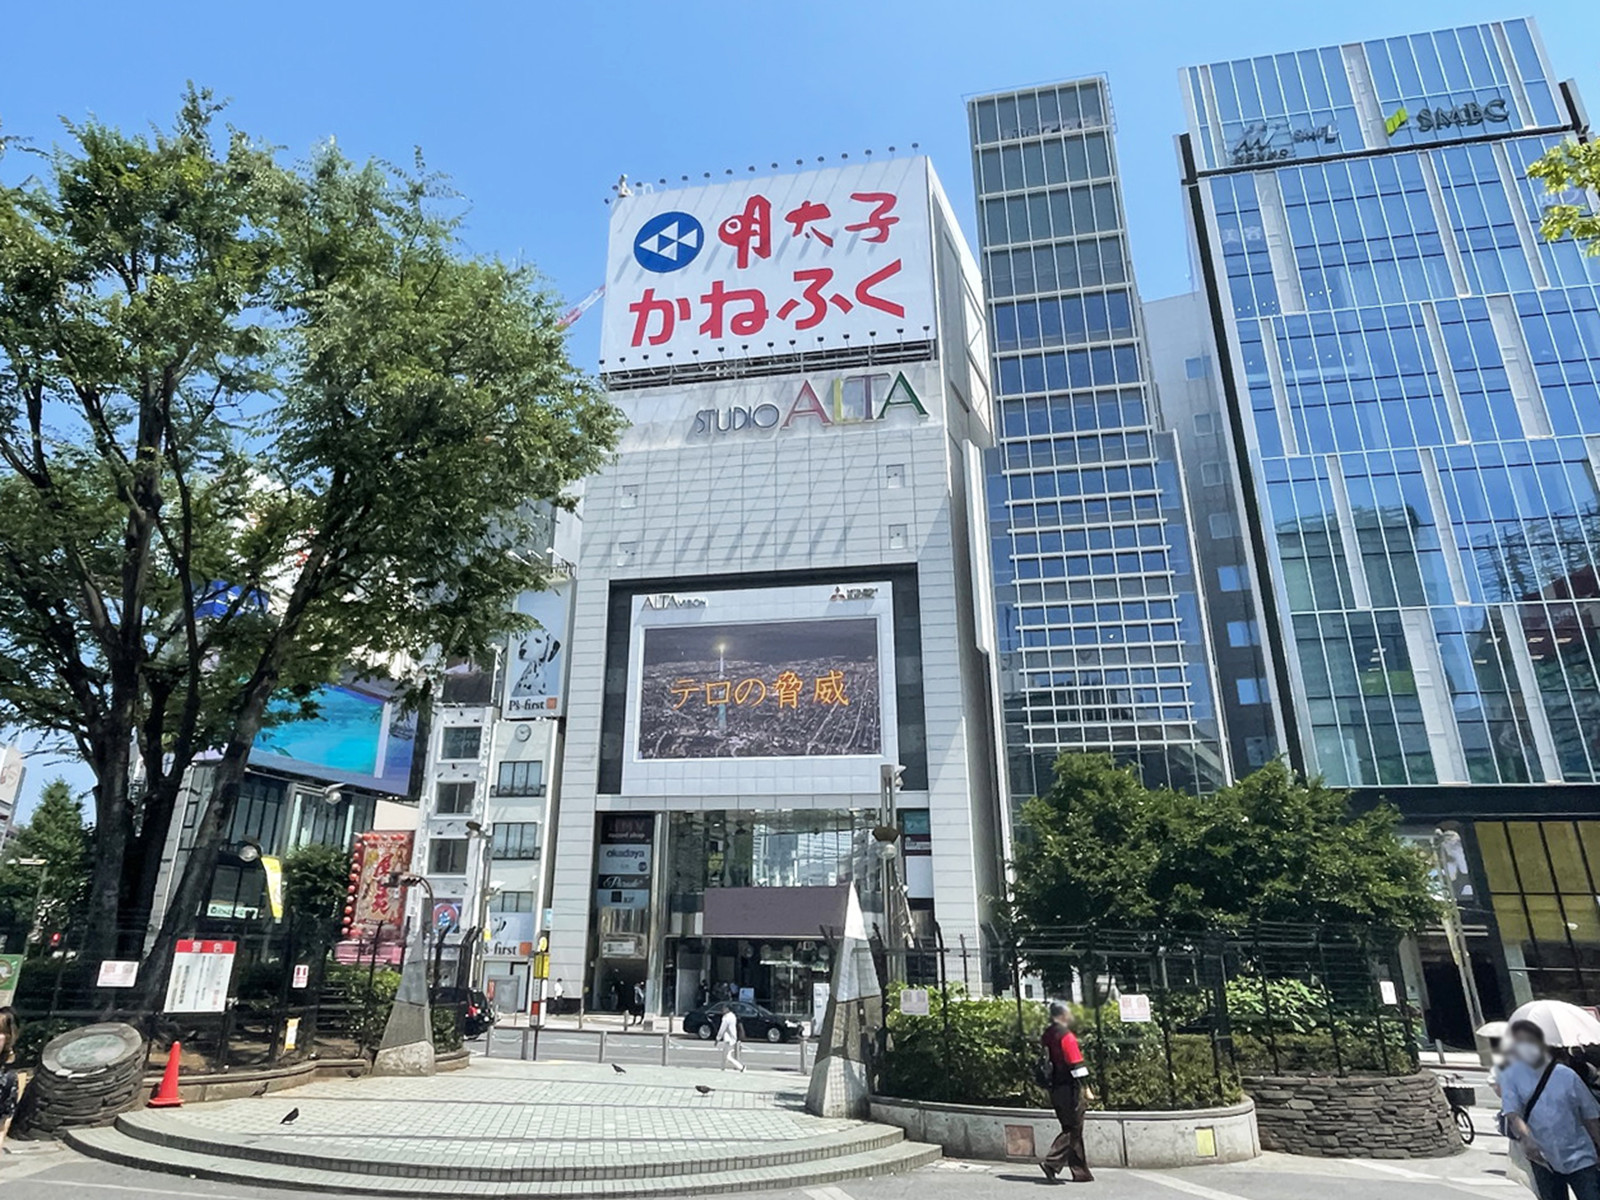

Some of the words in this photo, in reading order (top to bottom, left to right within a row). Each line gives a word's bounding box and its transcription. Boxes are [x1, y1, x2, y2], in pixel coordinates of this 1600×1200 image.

[1417, 99, 1509, 132] SMBC
[718, 192, 900, 269] 明太子
[628, 258, 905, 347] かねふく
[695, 403, 780, 433] STUDIO
[780, 370, 929, 430] ALTA
[670, 669, 850, 710] テロの脅威
